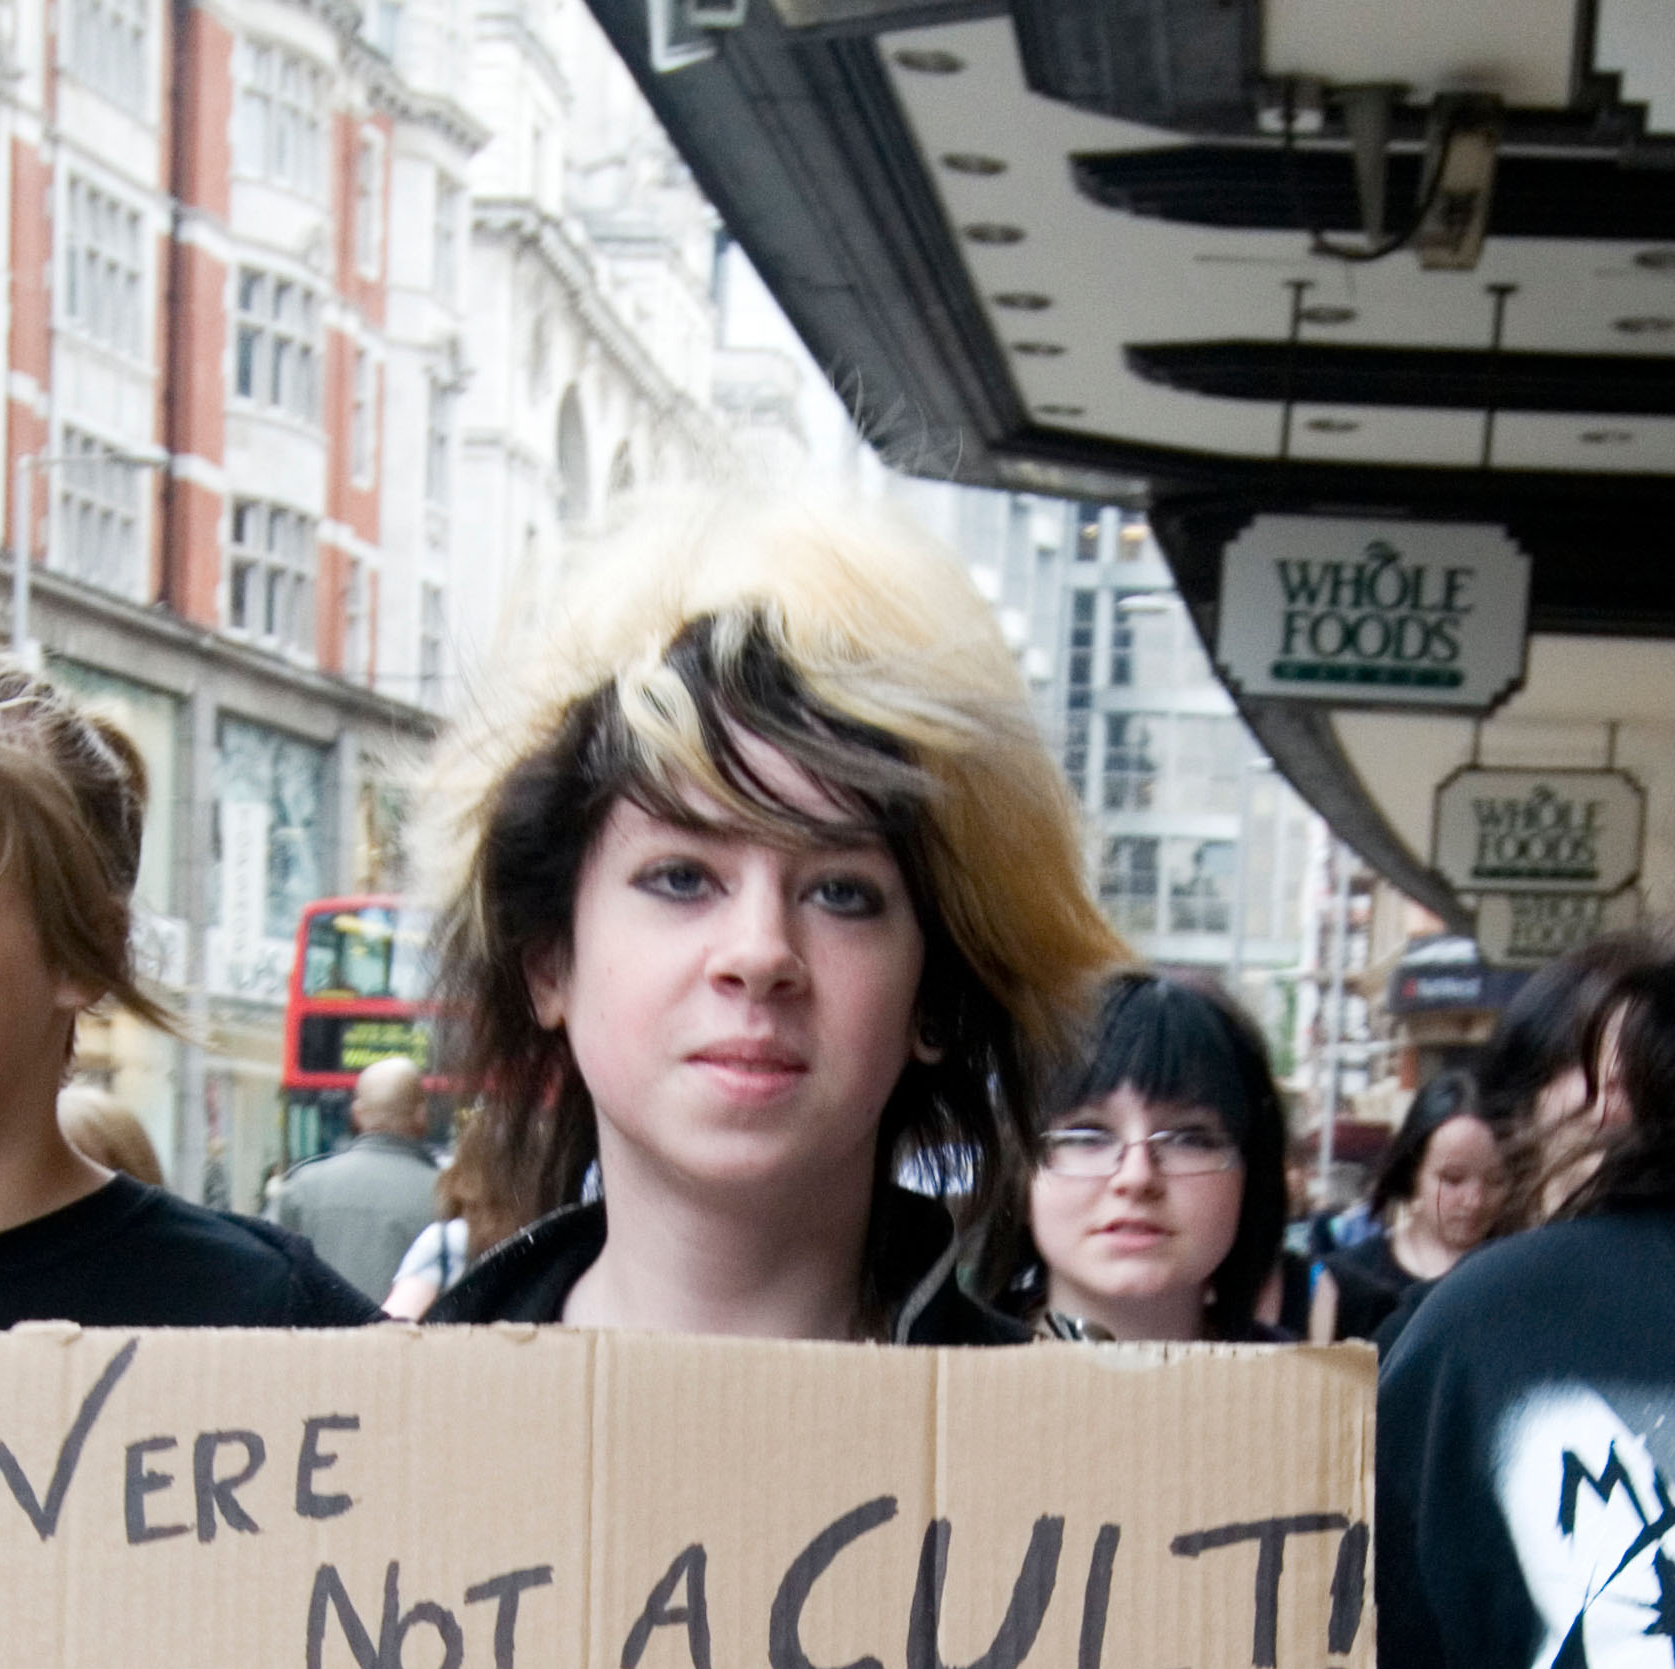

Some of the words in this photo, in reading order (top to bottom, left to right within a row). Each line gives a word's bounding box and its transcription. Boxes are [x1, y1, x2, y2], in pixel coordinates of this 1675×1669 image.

[1275, 548, 1473, 614] WHOLE
[1281, 610, 1461, 664] FOODS
[1473, 785, 1605, 832] WHOLE
[1478, 832, 1597, 868] FOODS
